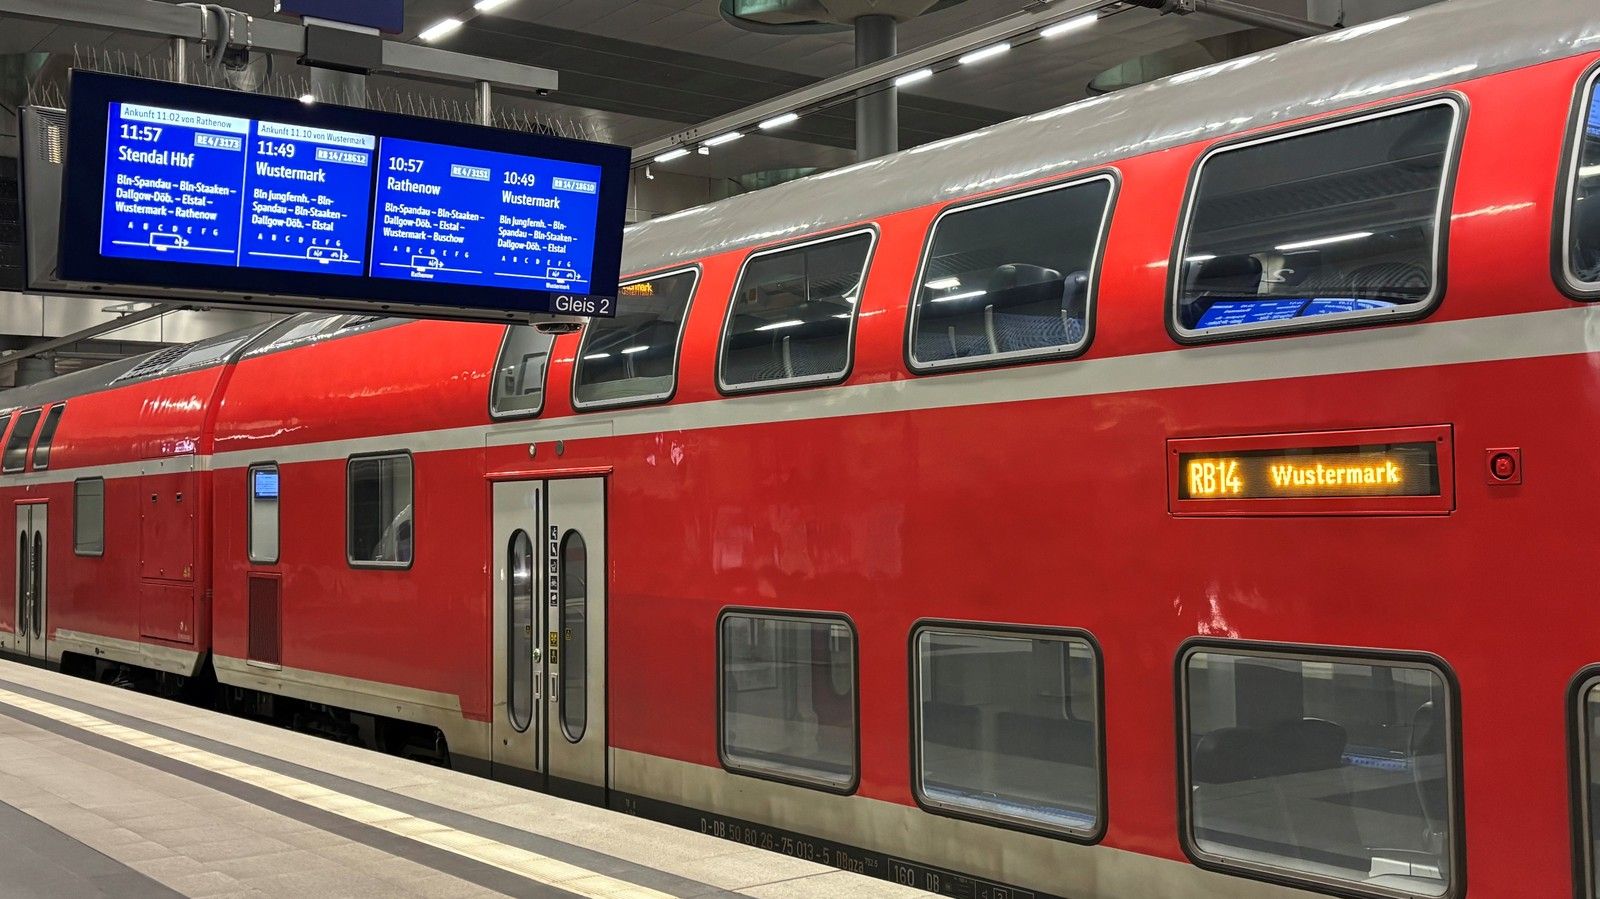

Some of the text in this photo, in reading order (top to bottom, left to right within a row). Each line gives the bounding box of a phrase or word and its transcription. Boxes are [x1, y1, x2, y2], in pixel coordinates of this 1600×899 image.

[124, 107, 154, 119] Ankunft
[157, 111, 180, 122] 11.02
[196, 116, 232, 128] Rathenow
[120, 124, 162, 142] 11:57
[261, 125, 289, 136] Ankunft
[291, 128, 312, 138] 11.10
[326, 133, 366, 145] Wustermark
[118, 146, 195, 168] Stendal Hbf
[257, 140, 295, 157] 11:49
[256, 161, 326, 182] Wustermark
[388, 157, 424, 173] 10:57
[117, 174, 172, 189] Bln-Spandau
[180, 181, 230, 195] Bln-Staaken
[387, 176, 441, 195] Rathenow
[503, 171, 535, 187] 10:49
[116, 188, 174, 203] Dallgow-Döb.
[182, 194, 206, 206] Elstal
[253, 188, 267, 199] Bln
[268, 190, 310, 203] Jungfernh.
[317, 195, 334, 206] Bln-
[502, 190, 560, 209] Wustermark
[115, 201, 167, 216] Wustermark
[175, 207, 218, 220] Rathenow
[252, 201, 287, 214] Spandau
[294, 206, 340, 219] Bln-Staaken
[385, 202, 430, 216] Bln-Spandau
[437, 208, 479, 221] Bln-Staaken
[252, 214, 304, 229] Dallgow-Döb.
[312, 220, 334, 231] Elstal
[384, 215, 432, 228] Dallgow-Döb.
[439, 220, 459, 231] Elstal
[499, 214, 511, 224] Bln
[512, 216, 546, 228] Jungfernh.
[553, 221, 567, 230] Bln-
[383, 227, 426, 240] Wustermark
[433, 232, 464, 243] Buschow
[498, 226, 527, 238] Spandau
[533, 230, 572, 242] Bln-Staaken
[498, 238, 541, 251] Dallgow-Döb.
[548, 243, 566, 253] Elstal
[556, 295, 609, 314] Gleis 2
[1190, 461, 1400, 493] RB14 Wustermark
[729, 824, 741, 842] 50
[744, 828, 757, 845] 80
[894, 864, 914, 887] 160
[926, 872, 940, 892] DB
